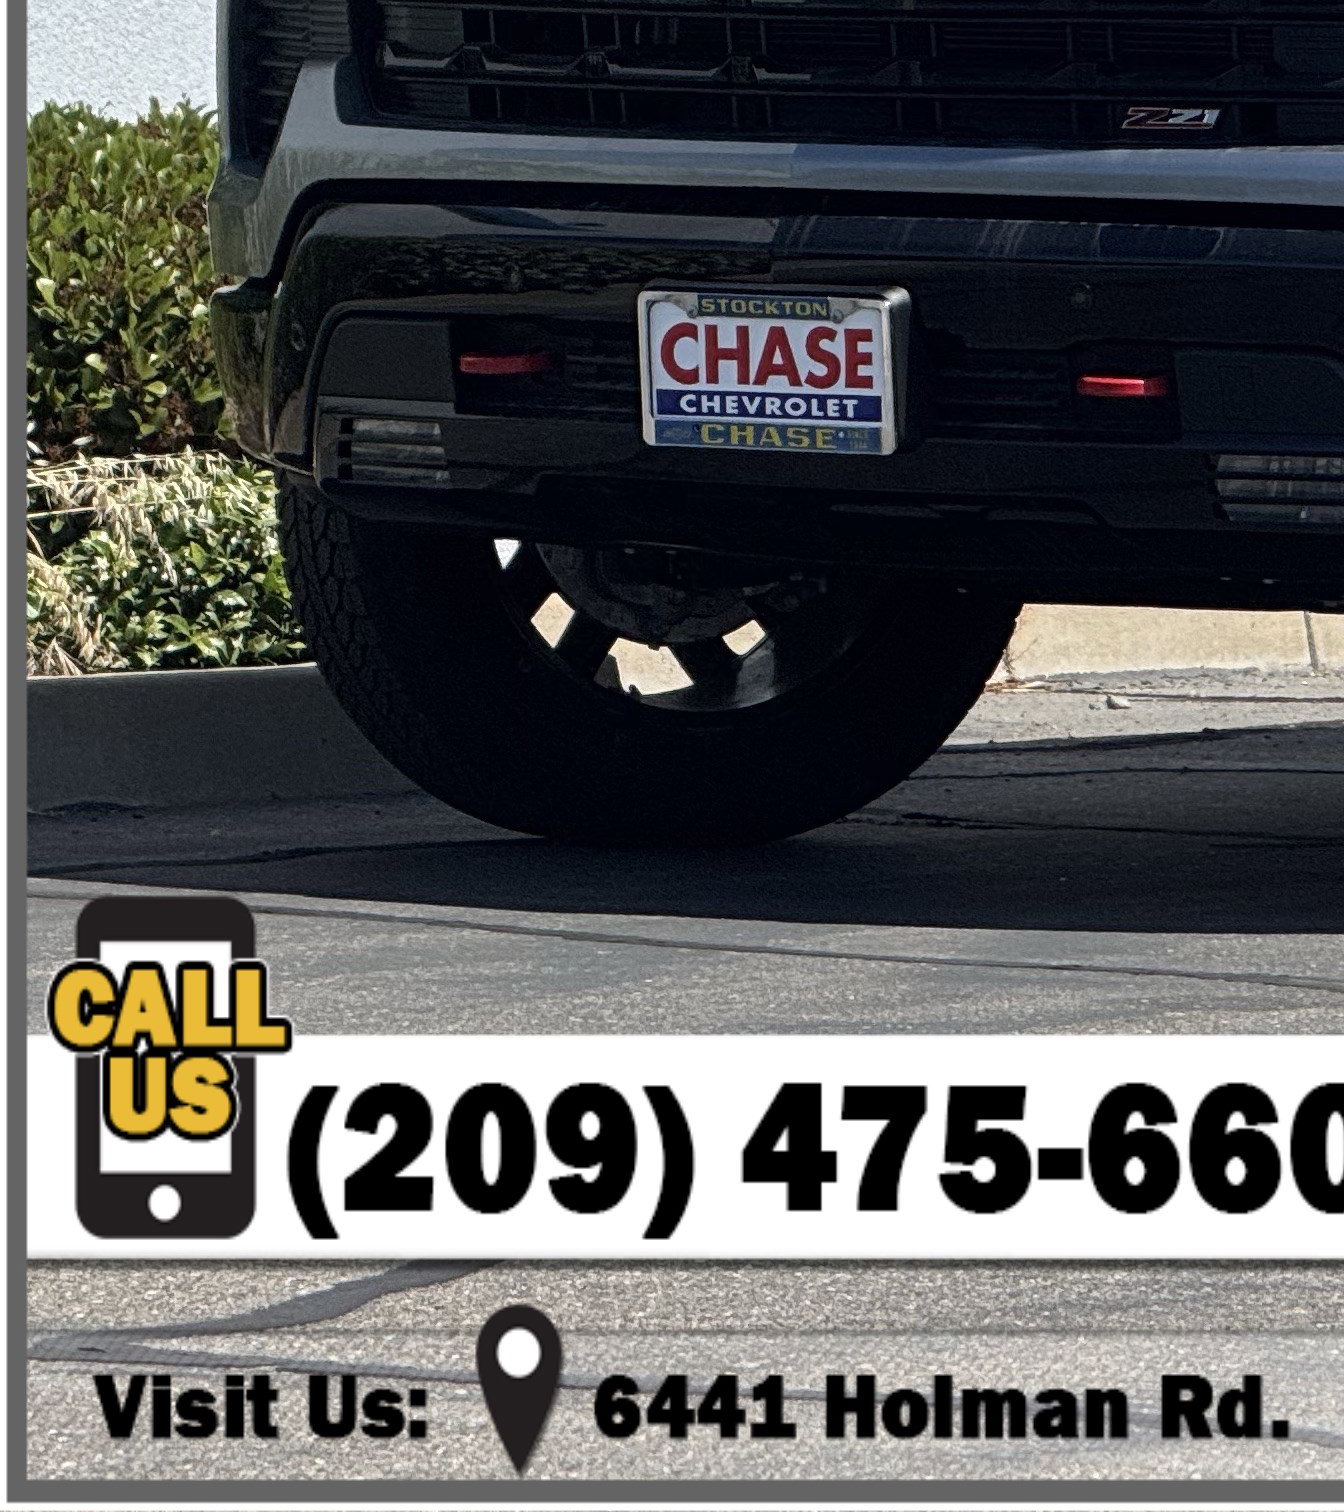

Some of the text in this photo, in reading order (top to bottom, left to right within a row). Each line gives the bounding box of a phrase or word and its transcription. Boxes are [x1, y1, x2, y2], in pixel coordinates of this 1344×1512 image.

[1121, 107, 1221, 129] Z71
[701, 297, 829, 317] STOCKTON
[660, 321, 875, 390] CHASE
[679, 393, 860, 419] CHEVROLET
[700, 423, 838, 450] CHASE
